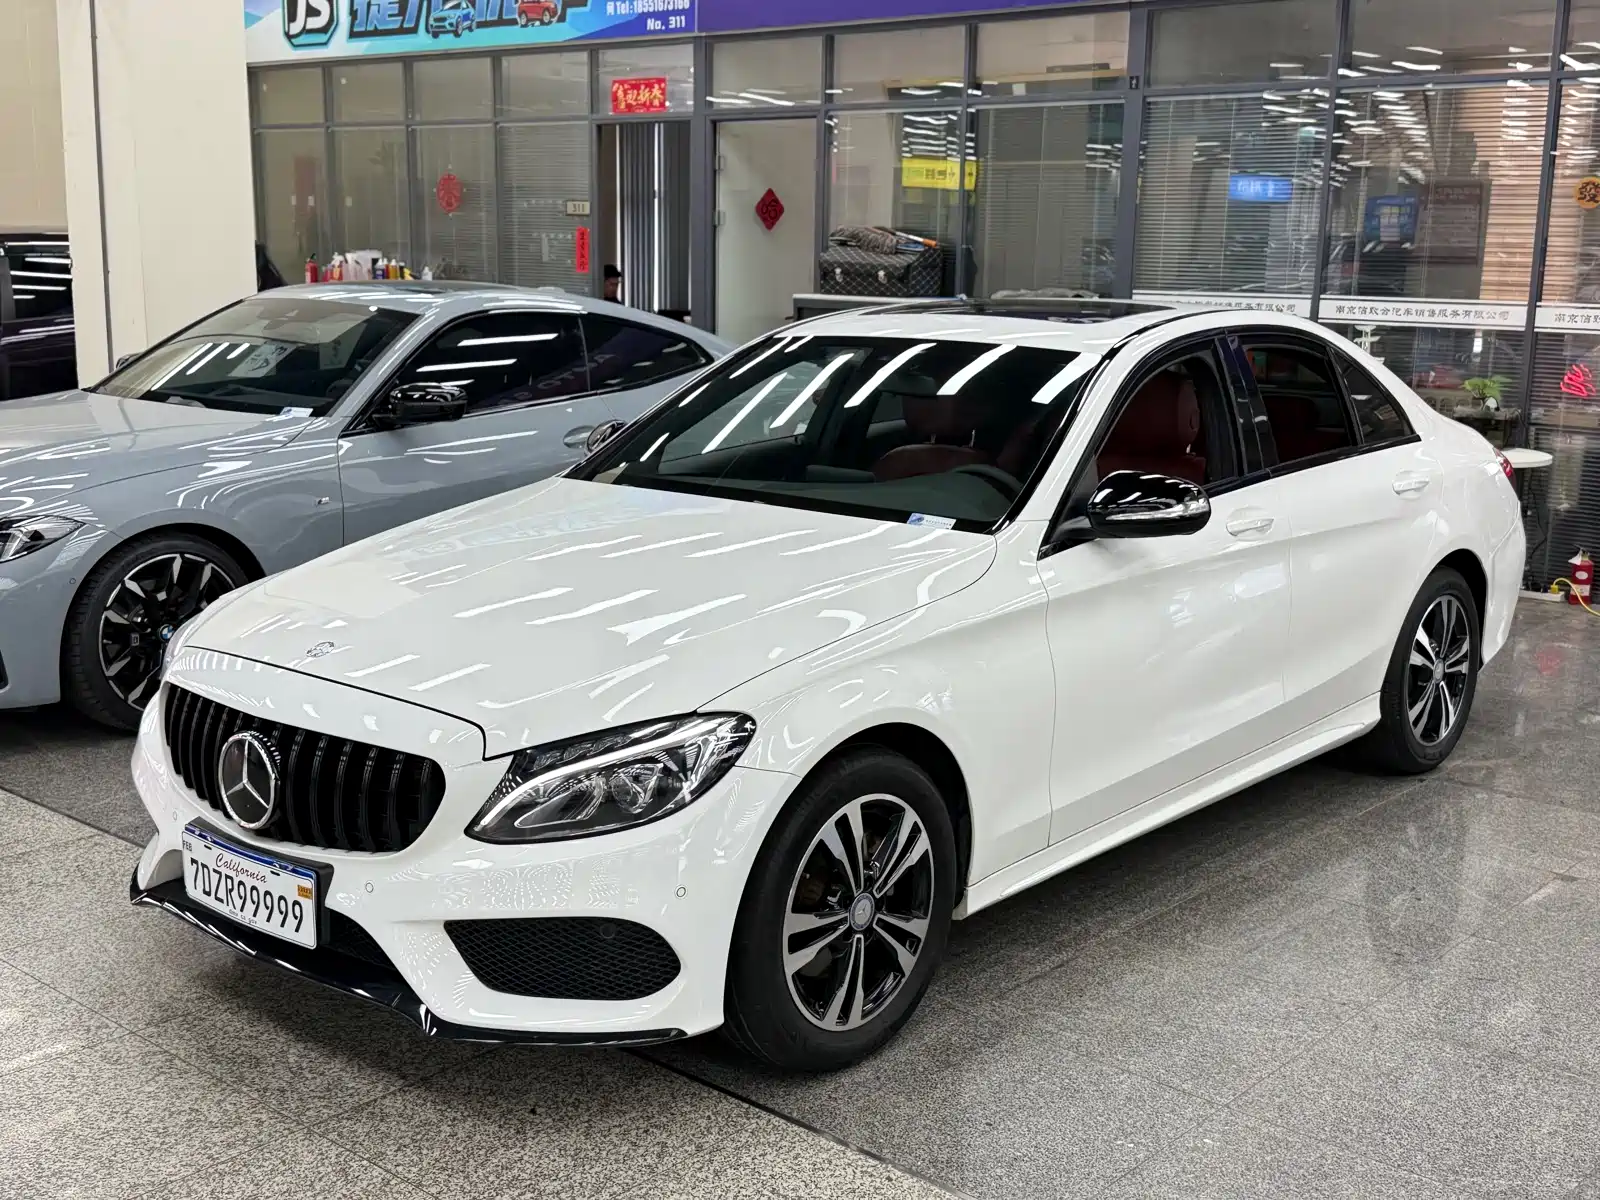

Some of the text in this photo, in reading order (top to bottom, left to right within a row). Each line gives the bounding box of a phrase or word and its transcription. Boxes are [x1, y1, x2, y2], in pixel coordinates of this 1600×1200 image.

[646, 15, 686, 31] No. 311
[215, 852, 268, 884] California
[190, 857, 304, 933] 7DZR99999
